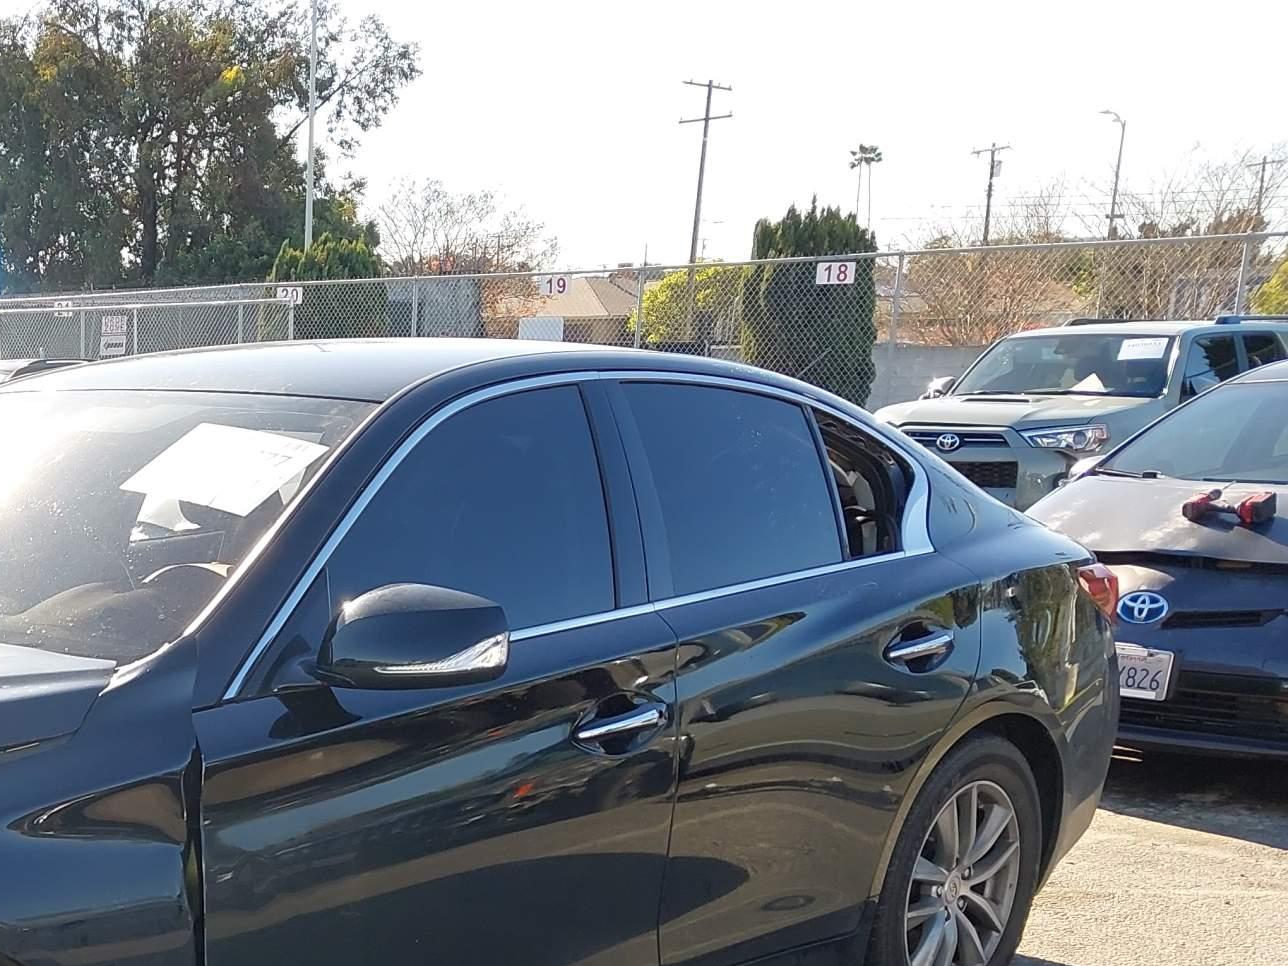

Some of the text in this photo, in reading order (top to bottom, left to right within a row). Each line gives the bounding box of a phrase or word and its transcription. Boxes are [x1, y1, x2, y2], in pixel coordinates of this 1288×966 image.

[824, 263, 849, 283] 18
[546, 277, 567, 294] 19
[281, 288, 299, 303] 20
